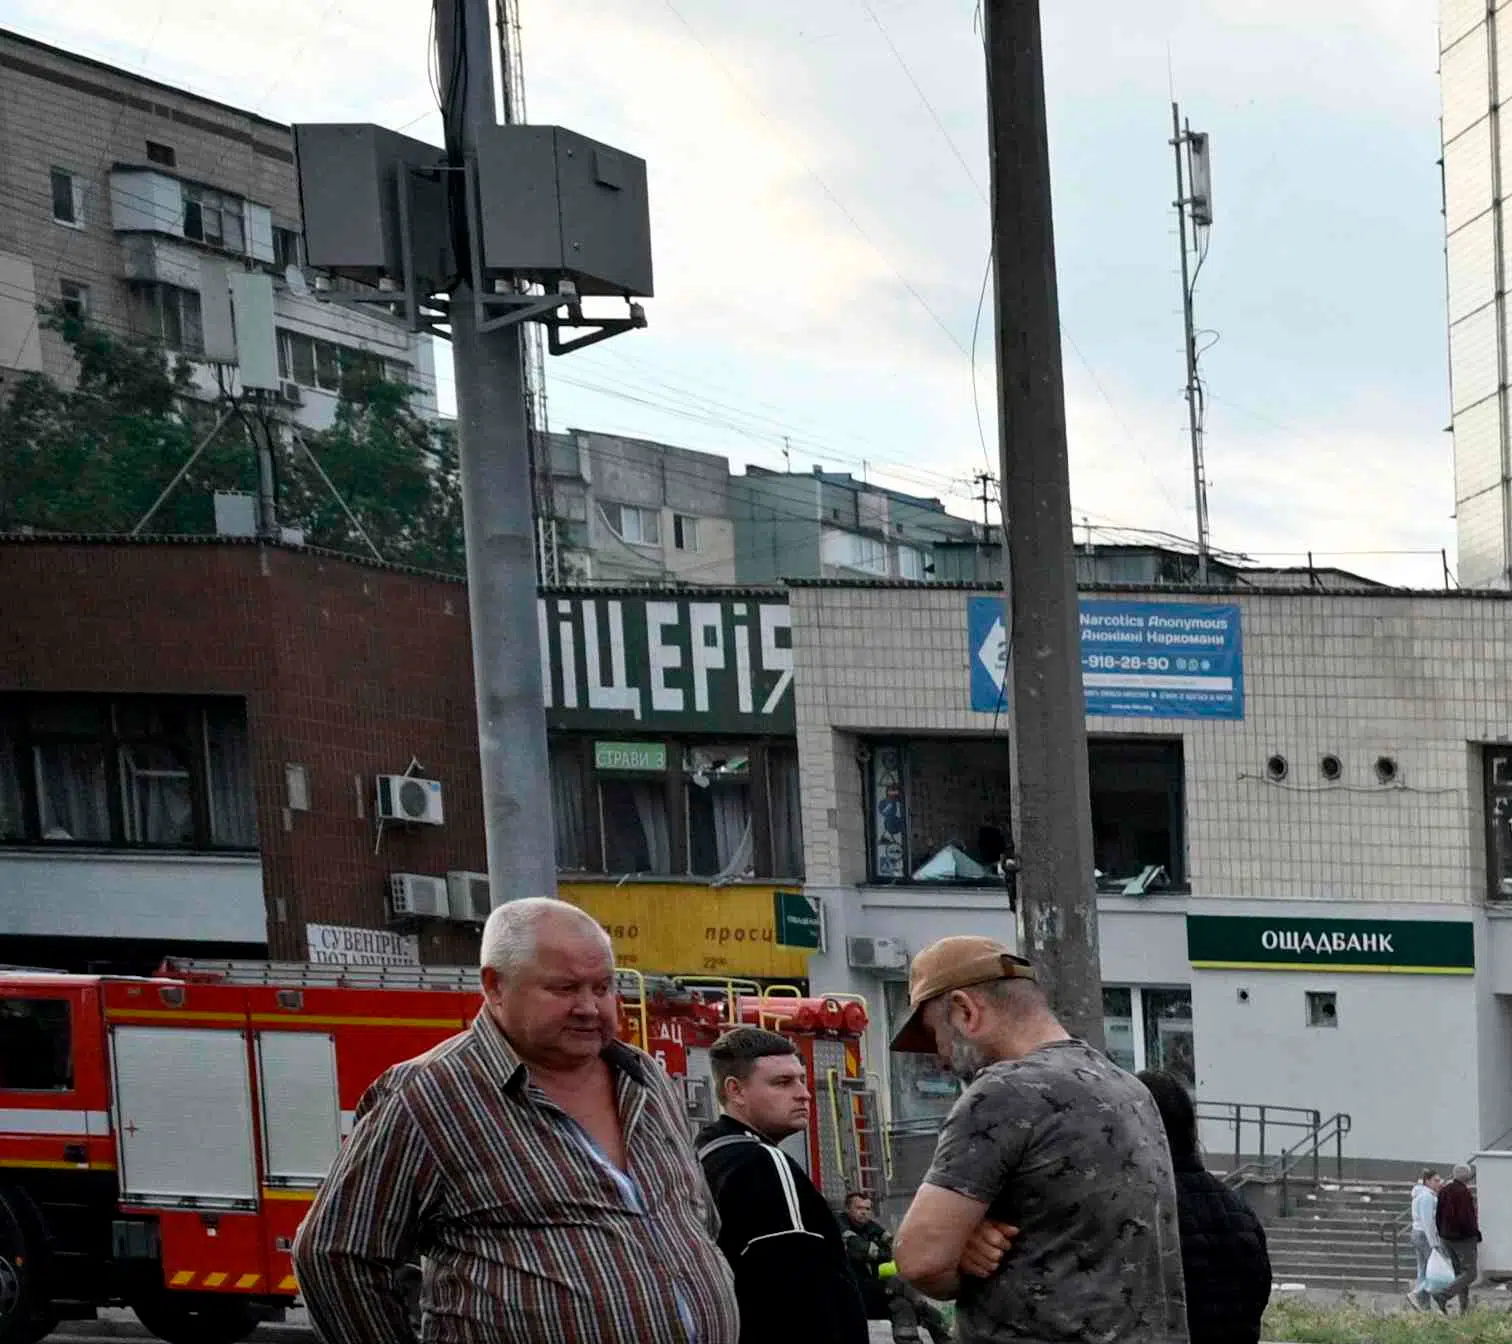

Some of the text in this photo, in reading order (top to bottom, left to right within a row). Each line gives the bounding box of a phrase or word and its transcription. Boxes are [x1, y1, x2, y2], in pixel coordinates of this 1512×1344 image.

[1079, 612, 1229, 631] Narcotics Anonymous
[1081, 629, 1225, 645] Анонімні Наркомани
[1261, 930, 1395, 954] ОЩАДБАНК
